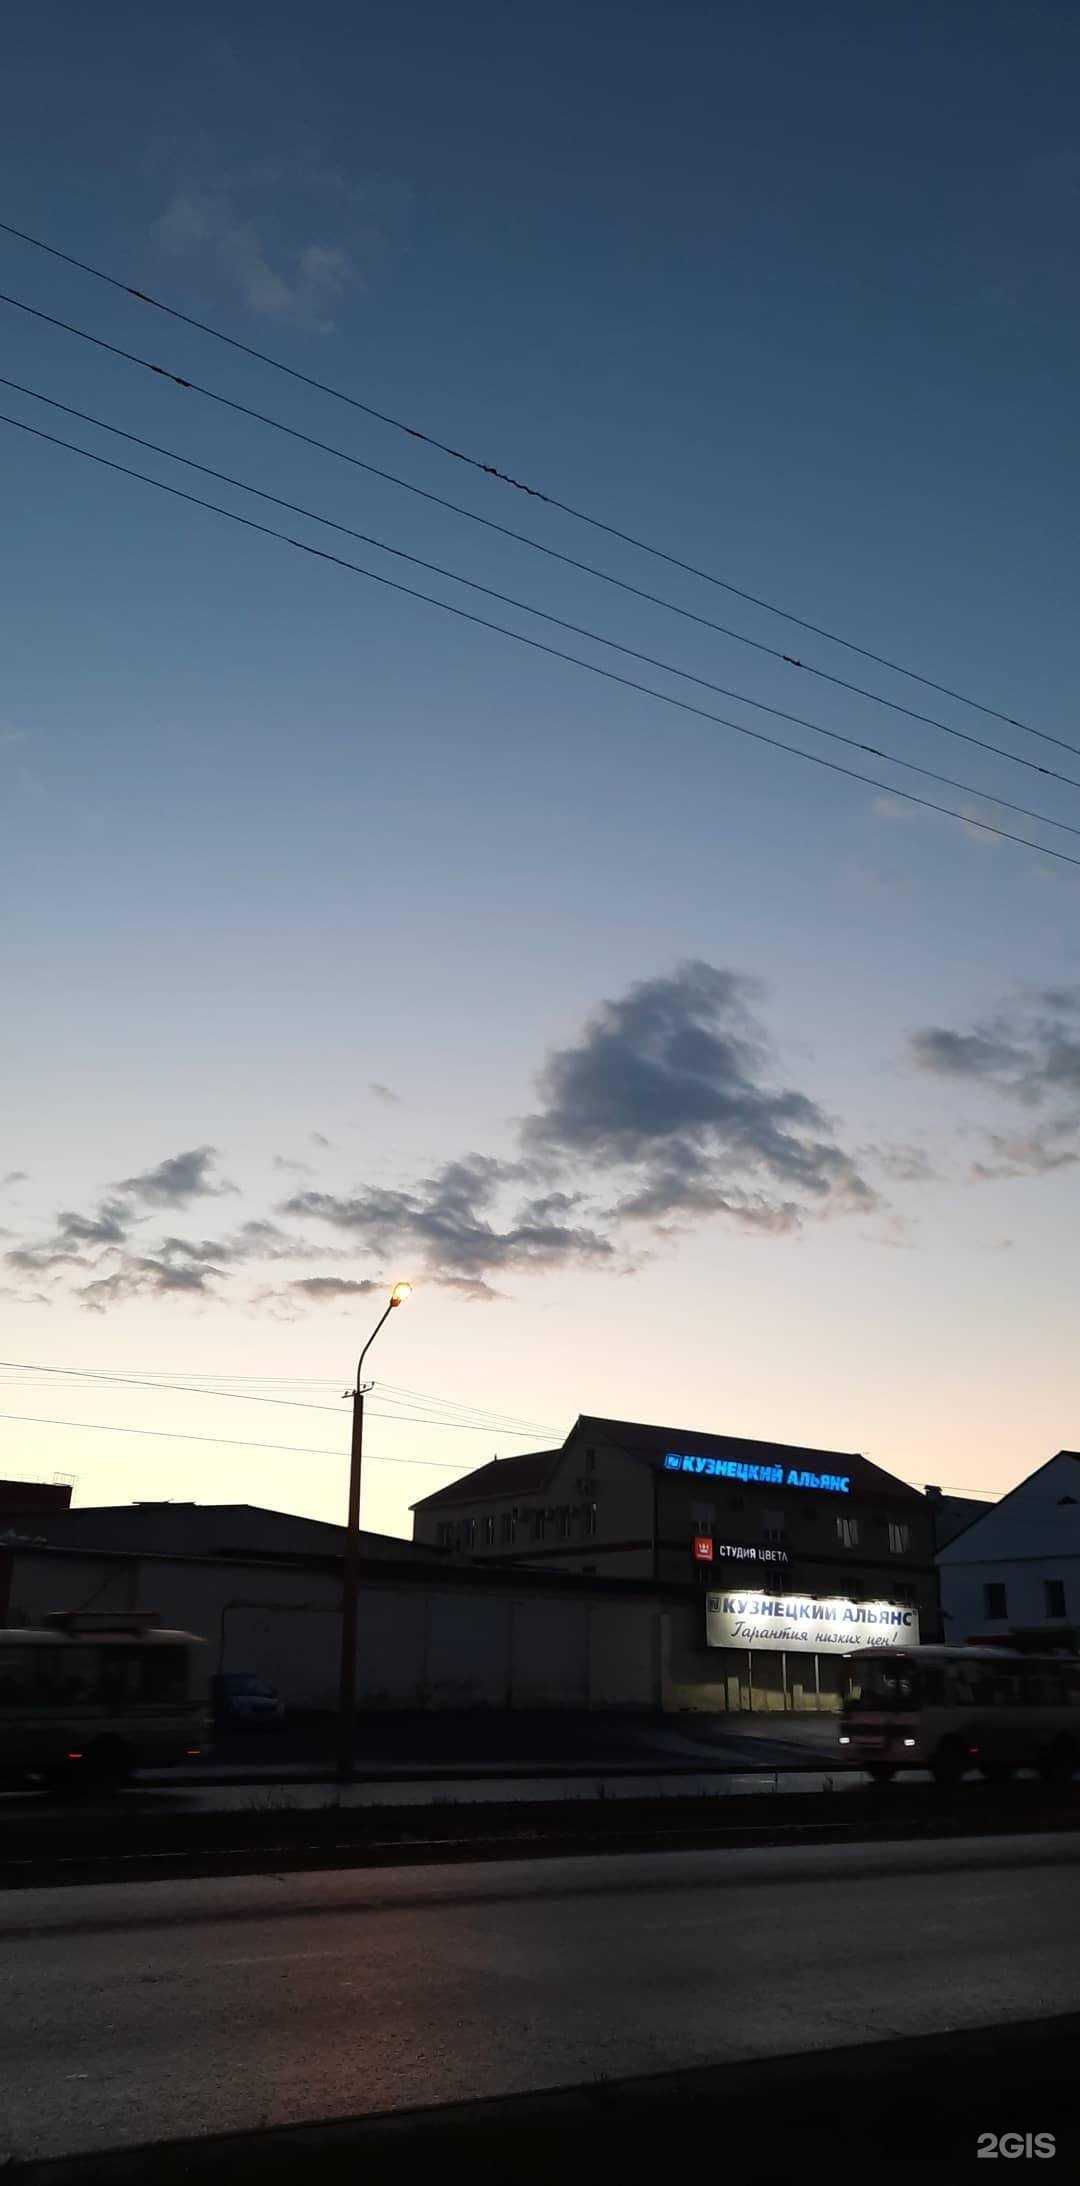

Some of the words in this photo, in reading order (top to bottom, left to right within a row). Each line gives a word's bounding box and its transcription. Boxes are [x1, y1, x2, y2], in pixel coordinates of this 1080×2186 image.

[682, 1456, 783, 1483] КУЗНЕЦКИЙ
[787, 1470, 849, 1492] АЛЬЯНС
[720, 1546, 756, 1559] СТУДИЯ
[843, 1608, 912, 1626] АЛЬЯНС
[731, 1621, 808, 1642] Гарантия
[815, 1632, 860, 1645] низких
[867, 1632, 898, 1646] цен!
